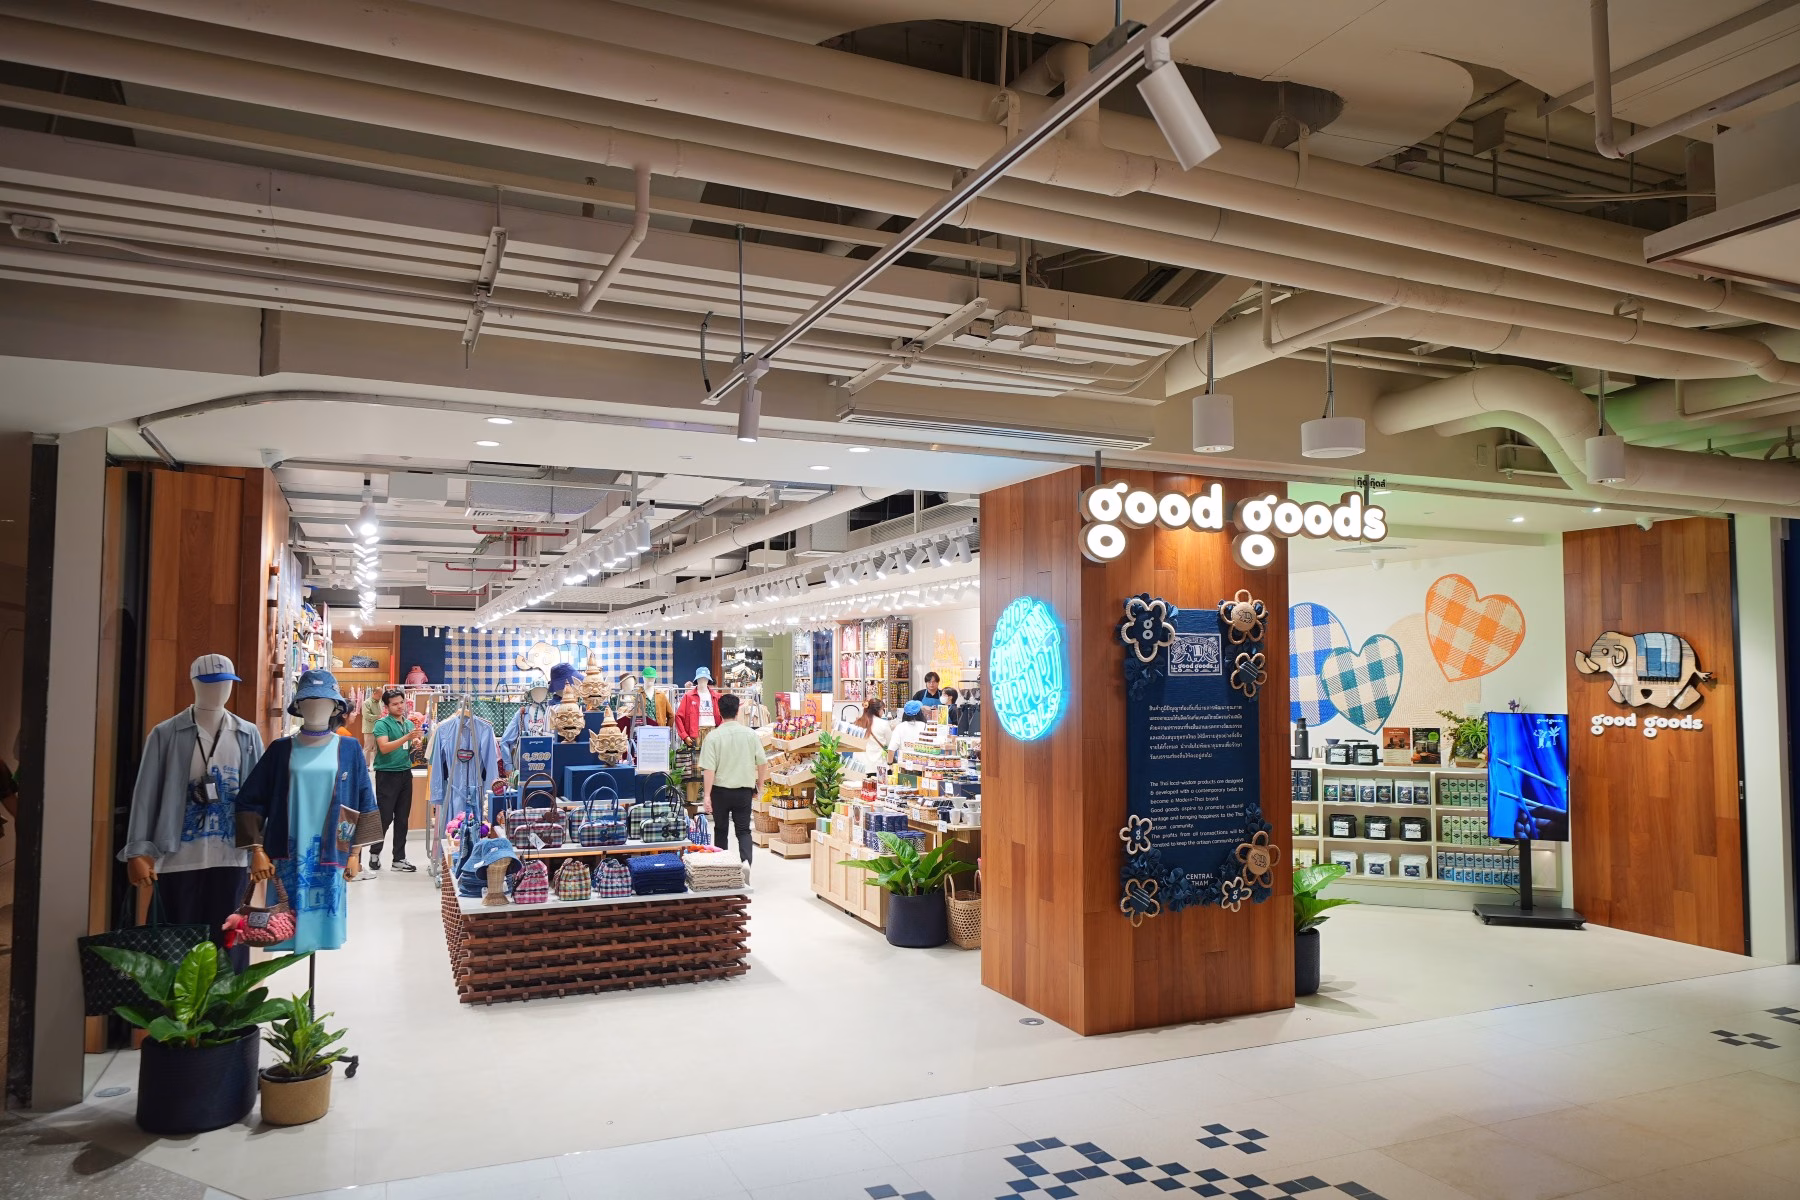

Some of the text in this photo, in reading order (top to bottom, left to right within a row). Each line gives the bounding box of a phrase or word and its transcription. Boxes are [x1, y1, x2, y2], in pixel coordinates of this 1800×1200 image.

[1086, 482, 1384, 568] good goods
[992, 596, 1032, 648] SHOP
[992, 631, 1062, 715] SUPPORT
[1178, 663, 1213, 672] good goods
[999, 690, 1061, 740] LOCALS
[1590, 713, 1703, 738] good goods
